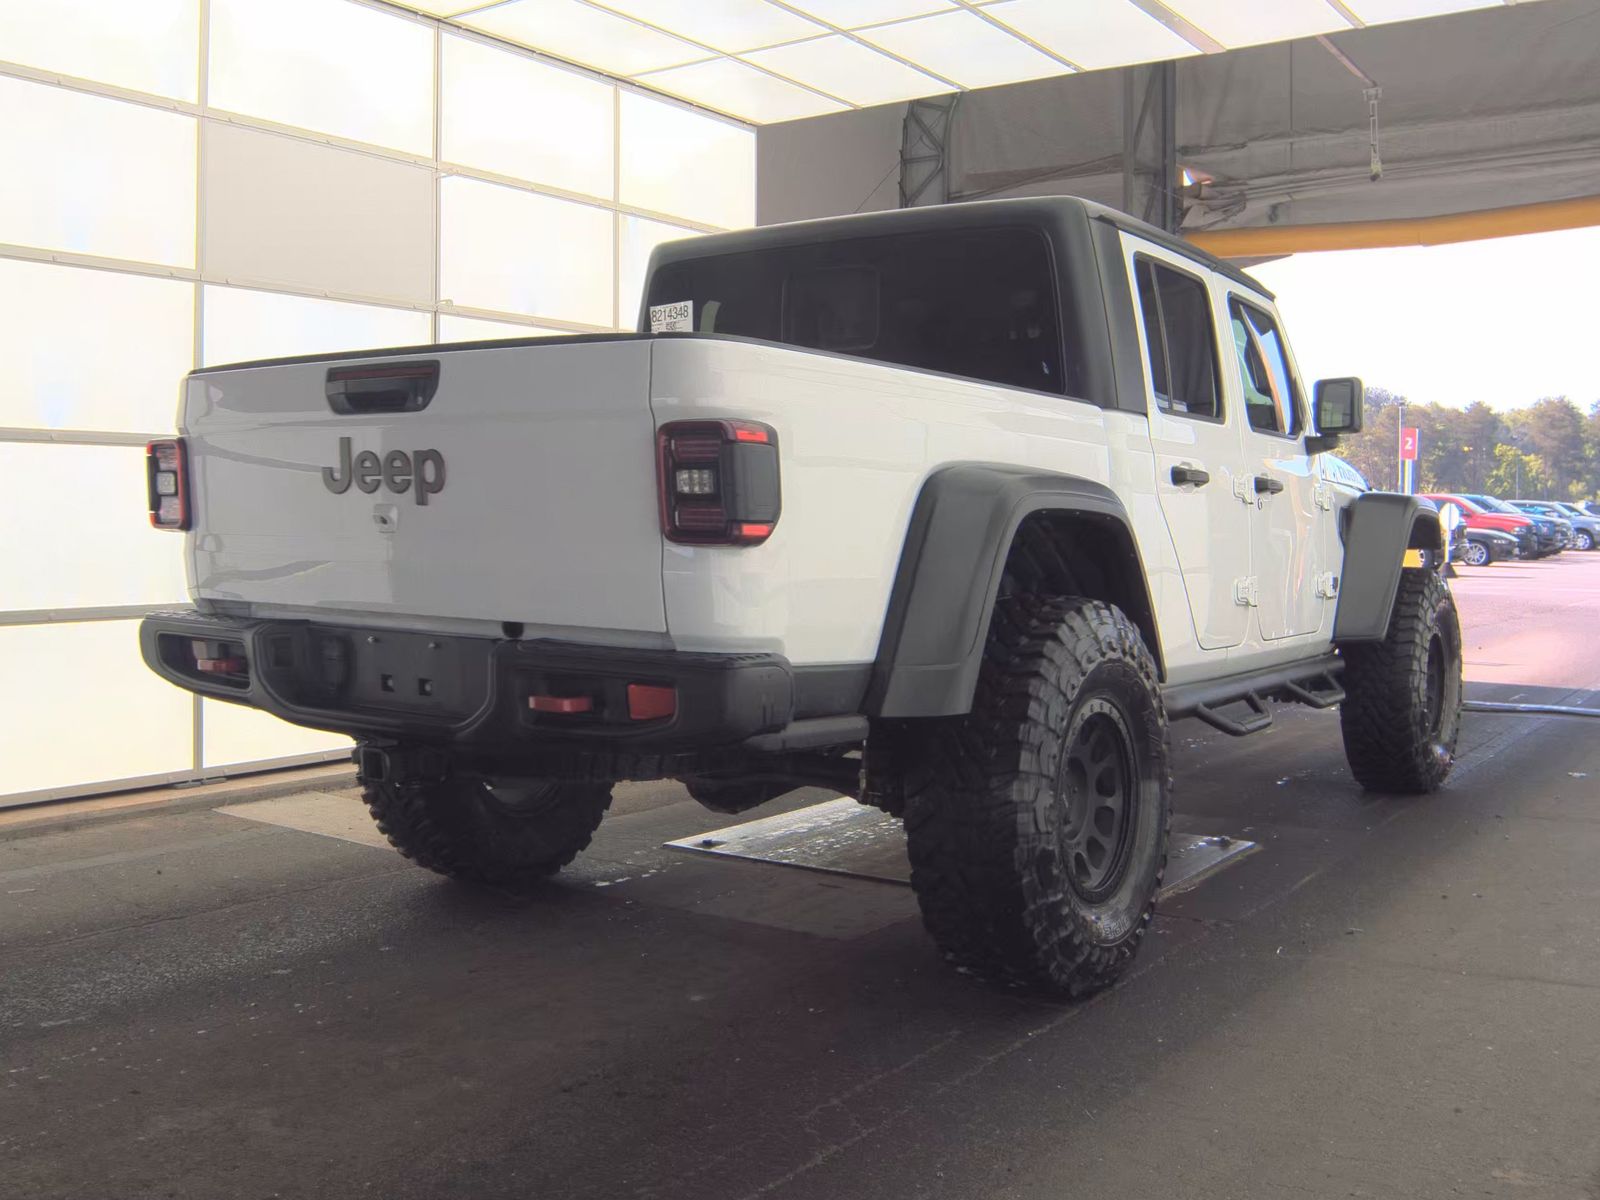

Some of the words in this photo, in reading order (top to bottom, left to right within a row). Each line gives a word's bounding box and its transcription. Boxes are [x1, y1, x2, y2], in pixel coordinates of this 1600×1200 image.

[651, 305, 689, 323] 8214348
[1404, 437, 1413, 450] 2
[321, 436, 446, 506] Jeep
